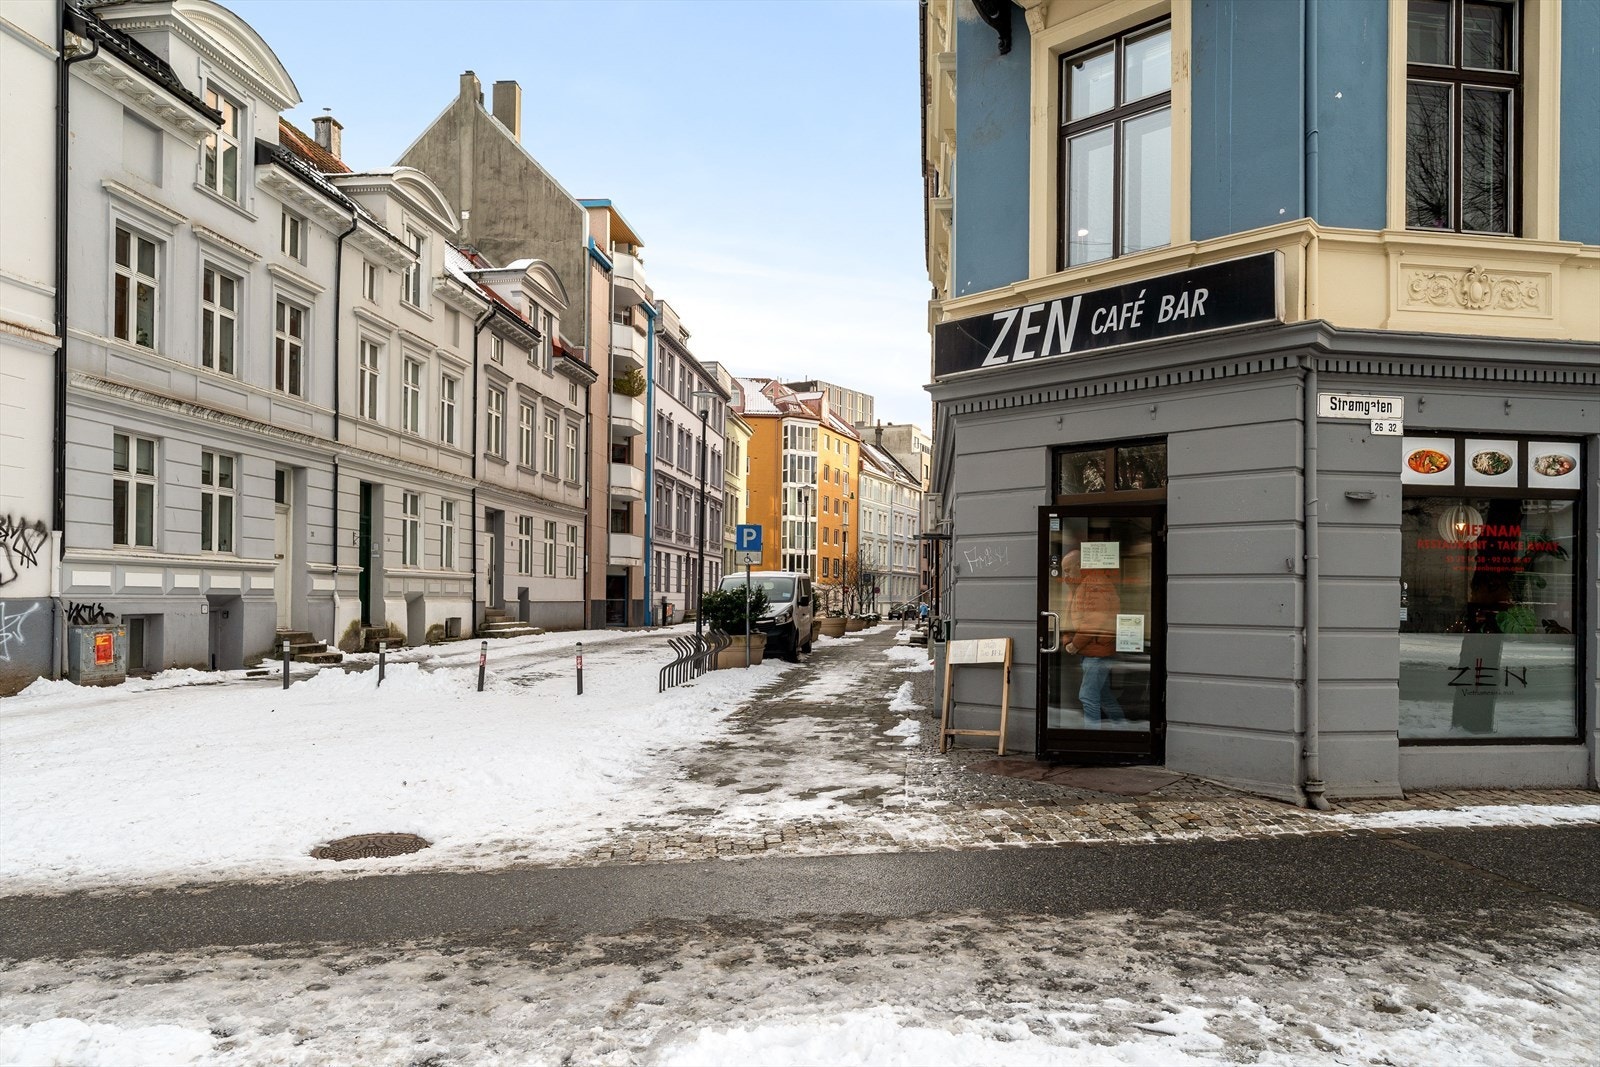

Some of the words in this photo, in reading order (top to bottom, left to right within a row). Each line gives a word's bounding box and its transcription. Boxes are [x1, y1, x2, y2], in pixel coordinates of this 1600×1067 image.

[981, 295, 1082, 367] ZEN
[1091, 288, 1145, 336] CAFÉ
[1157, 287, 1209, 324] BAR
[1330, 396, 1393, 415] Strømgaten
[1374, 422, 1384, 432] 26
[1388, 423, 1397, 432] 32
[743, 528, 757, 548] P
[1456, 524, 1521, 537] VIETNAM
[1417, 539, 1487, 550] RESTAURANT
[1498, 540, 1524, 551] TAKE
[1447, 658, 1528, 688] ZEN
